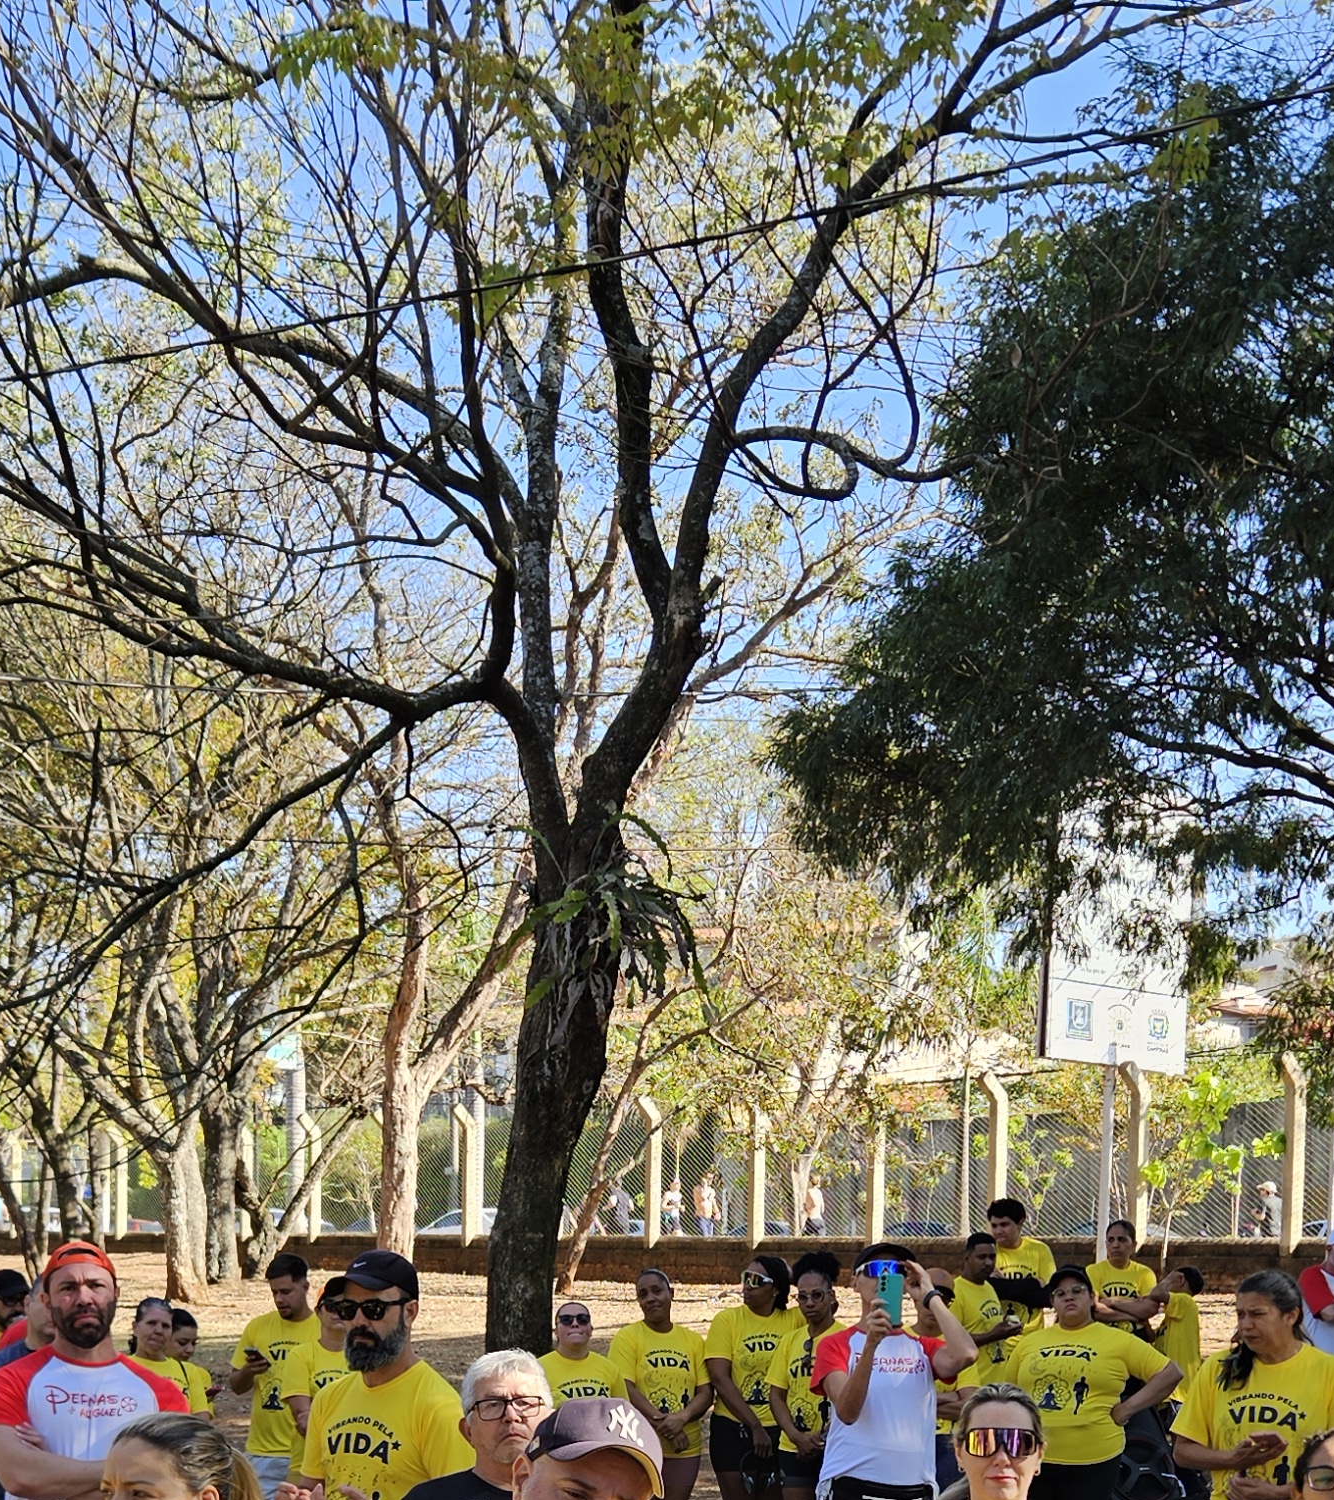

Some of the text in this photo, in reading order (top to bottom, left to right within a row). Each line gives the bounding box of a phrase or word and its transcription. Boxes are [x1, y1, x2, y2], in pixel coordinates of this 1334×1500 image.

[1103, 1287, 1138, 1299] VIDA
[744, 1341, 776, 1353] VID
[269, 1349, 288, 1361] VI
[1040, 1350, 1091, 1362] VIDA
[647, 1357, 690, 1371] VIDA
[561, 1386, 610, 1399] VIDA
[1228, 1393, 1299, 1410] VIBRANDO PELA
[1228, 1406, 1296, 1432] VIDA
[327, 1416, 394, 1440] VIBRANDO PELA
[327, 1433, 389, 1465] VIDA
